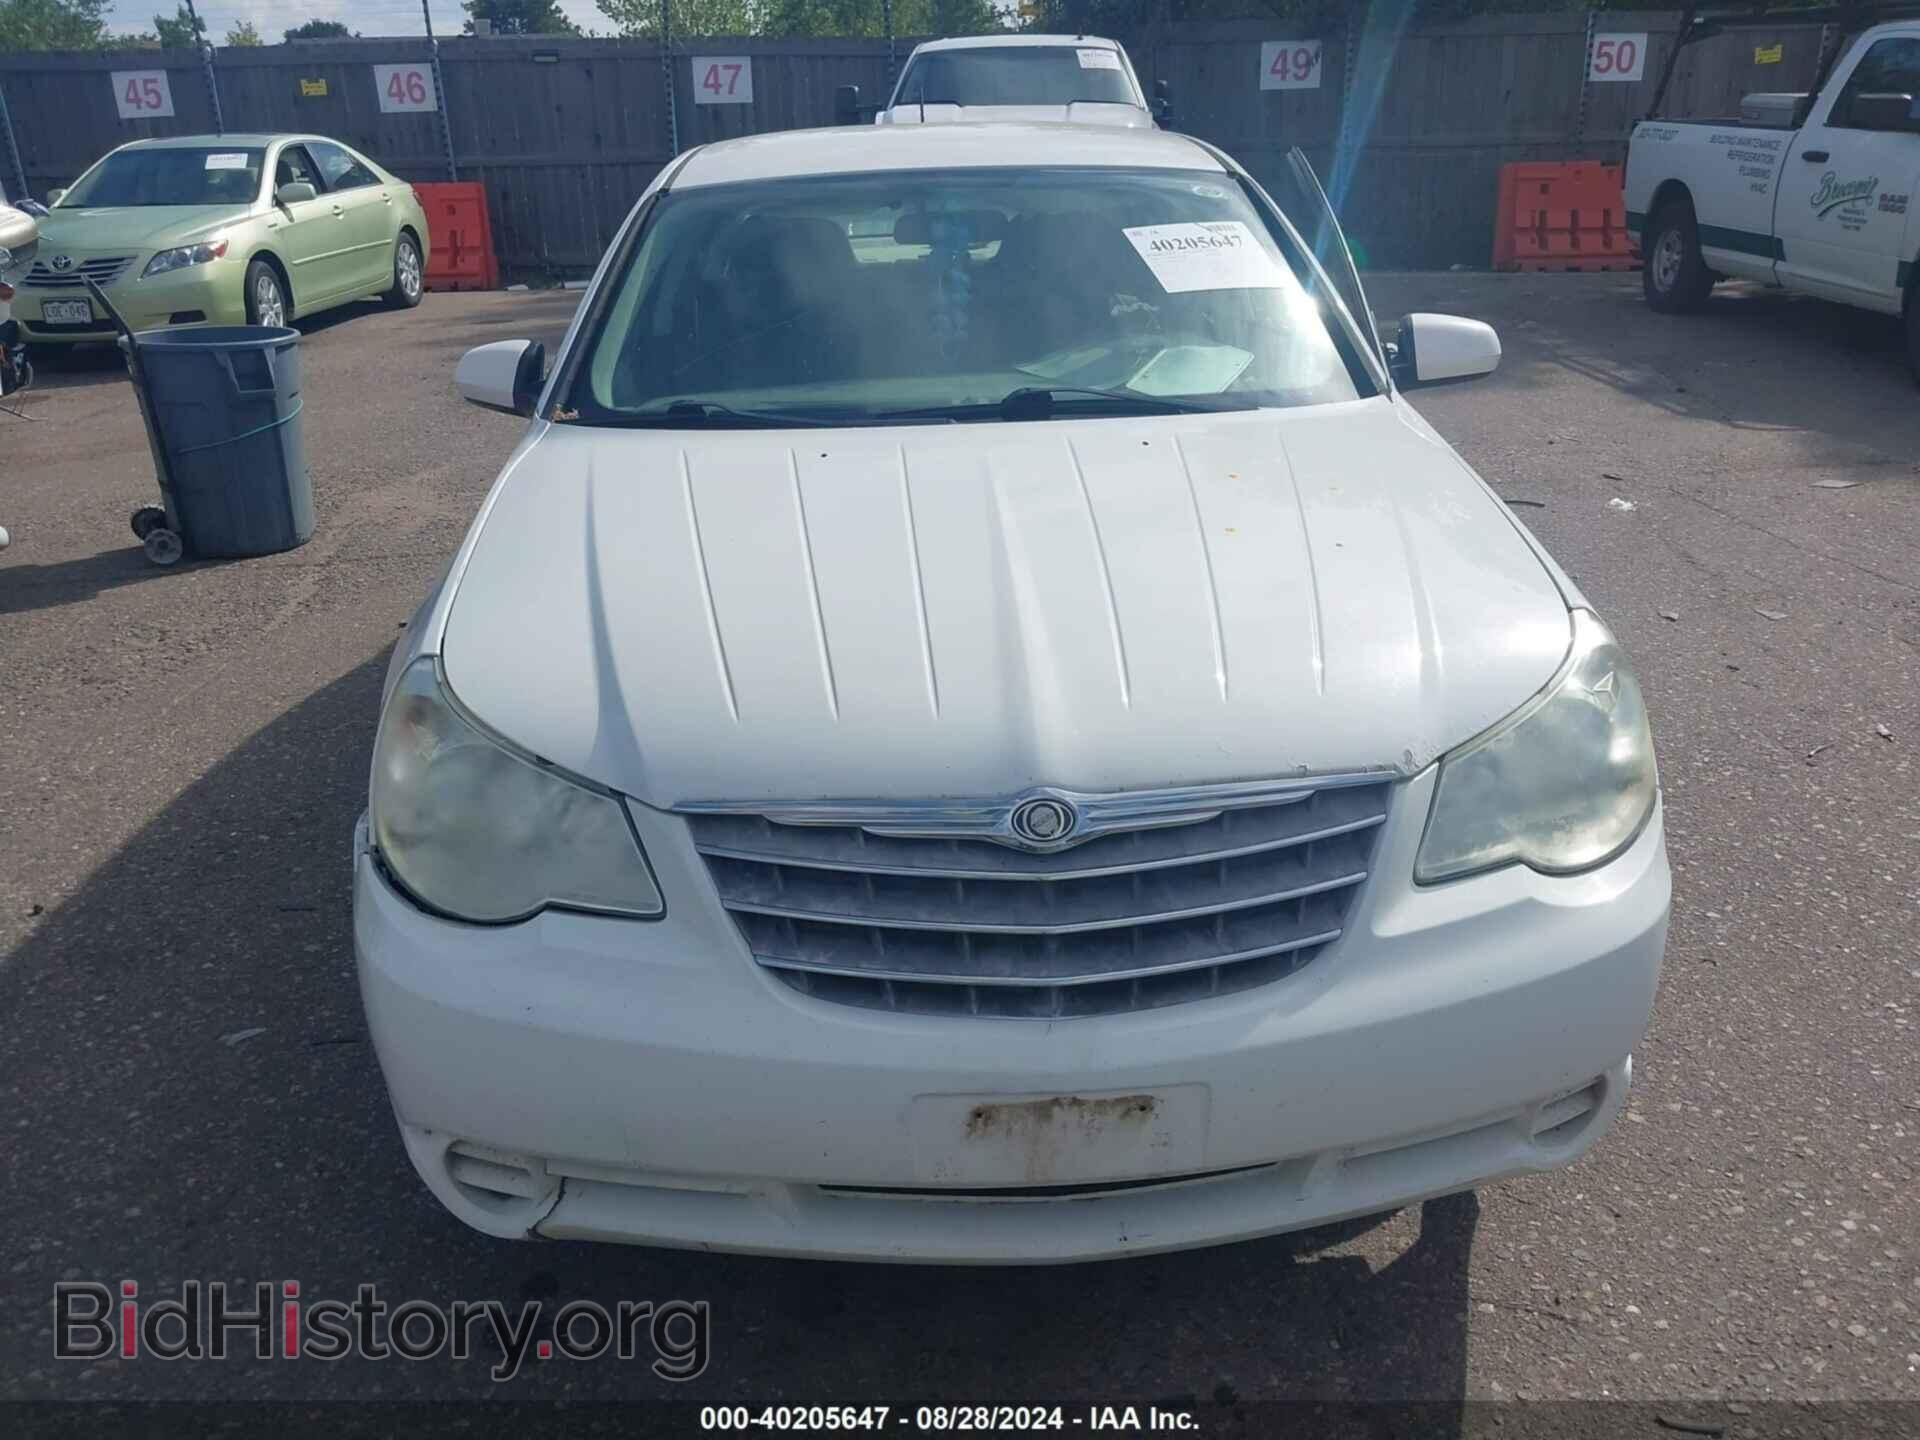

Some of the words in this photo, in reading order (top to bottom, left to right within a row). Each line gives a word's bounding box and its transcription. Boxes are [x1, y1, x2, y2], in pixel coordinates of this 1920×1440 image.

[1270, 47, 1312, 81] 49
[1593, 40, 1636, 74] 50
[125, 77, 163, 110] 45
[387, 71, 426, 104] 46
[702, 63, 742, 95] 47
[1149, 235, 1243, 253] 40205647
